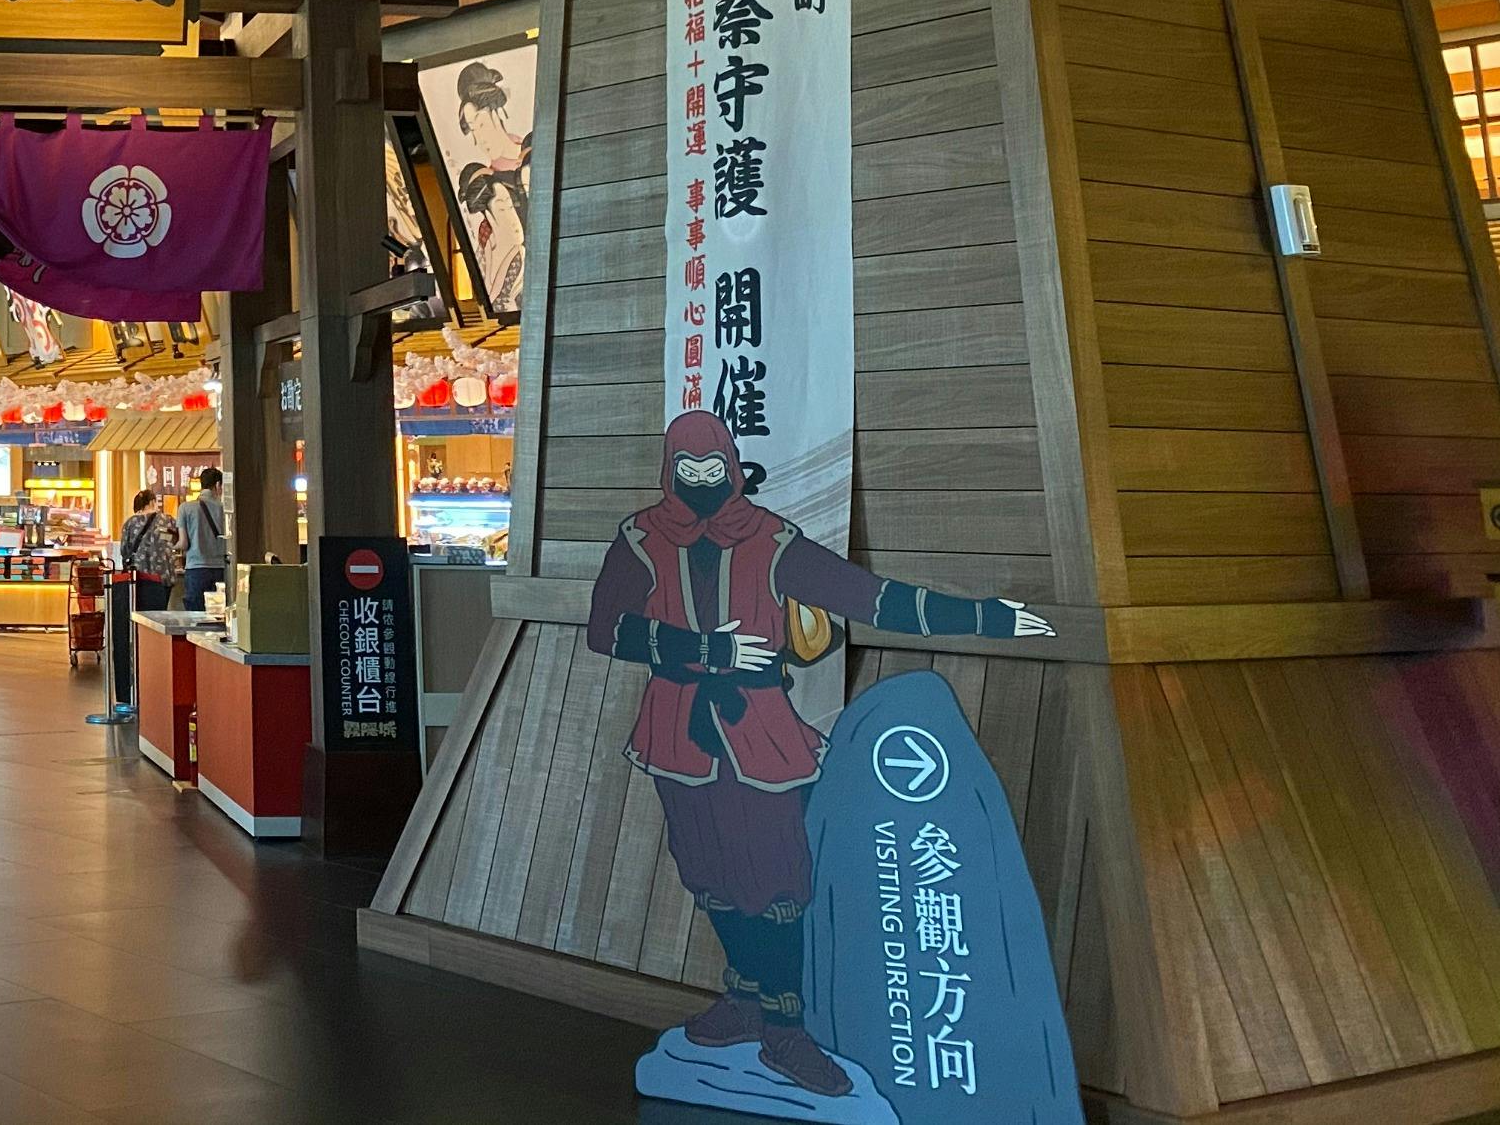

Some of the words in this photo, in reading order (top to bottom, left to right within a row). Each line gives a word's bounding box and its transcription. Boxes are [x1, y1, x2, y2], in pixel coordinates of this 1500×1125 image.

[339, 600, 350, 656] CHECOUT
[353, 597, 381, 713] 收銀櫃台
[340, 659, 352, 715] COUNTER
[874, 820, 904, 936] VISITING
[883, 940, 916, 1087] DIRECTION
[910, 821, 978, 1096] 參觀方向
